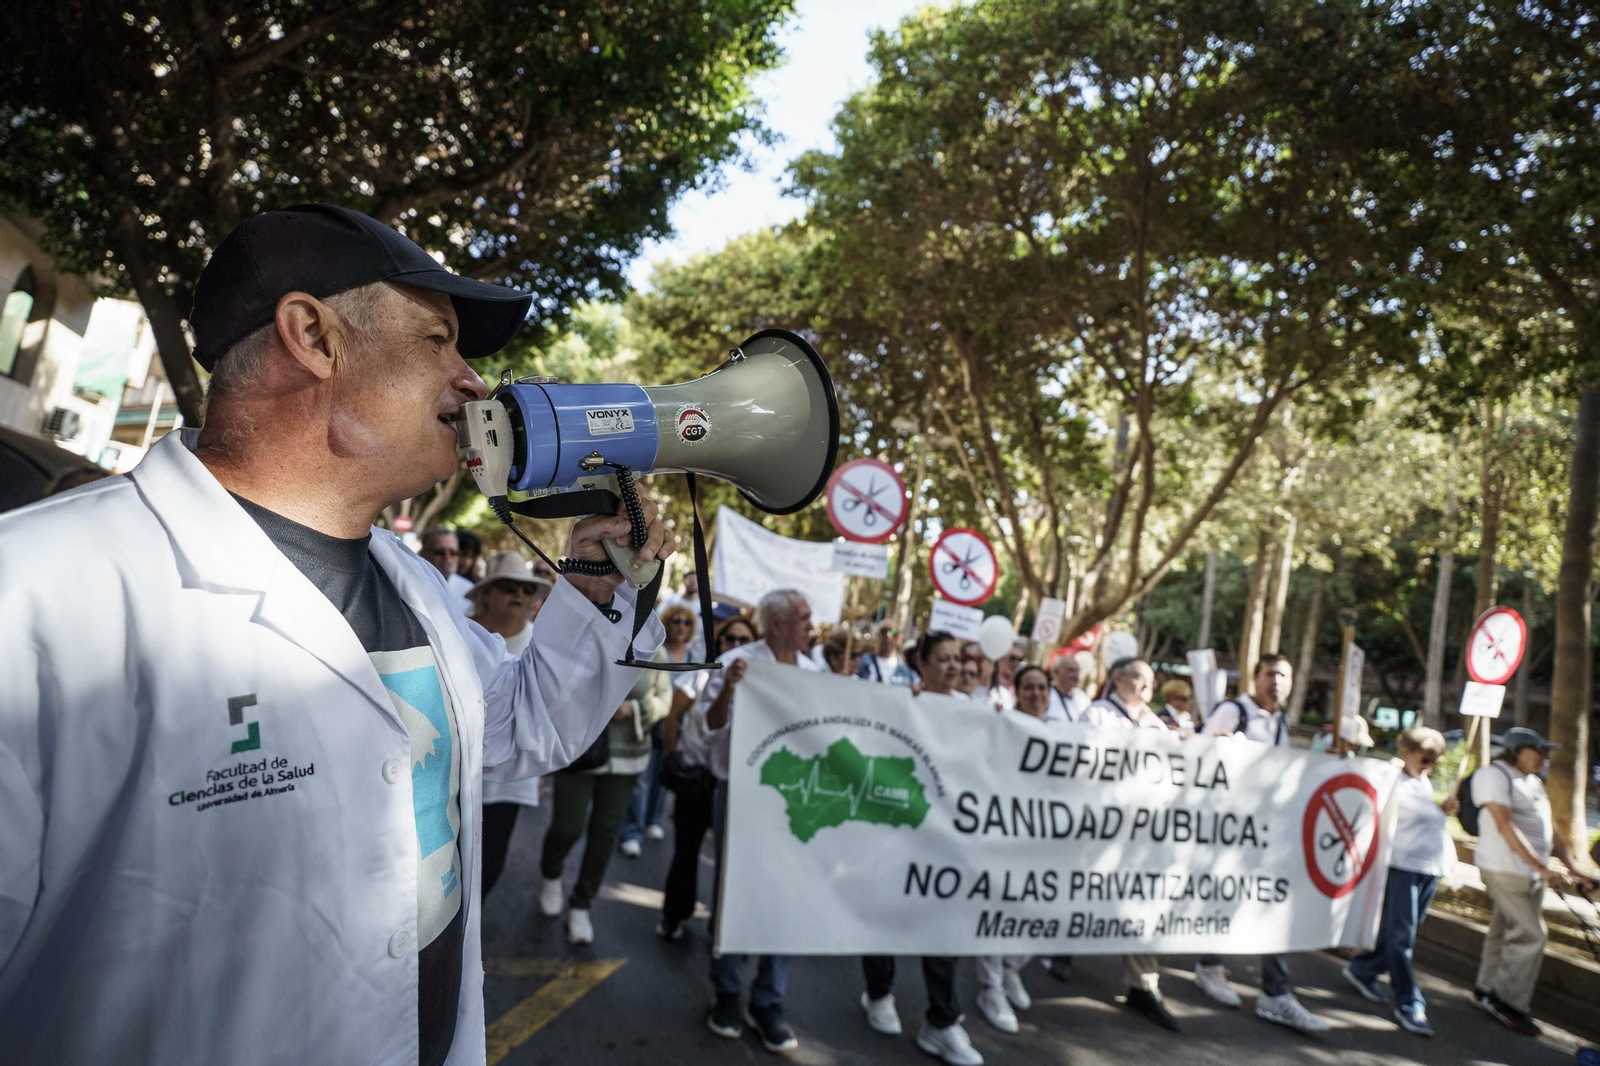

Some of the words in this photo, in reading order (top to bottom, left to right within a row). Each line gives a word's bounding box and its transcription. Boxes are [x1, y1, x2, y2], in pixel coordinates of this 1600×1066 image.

[588, 409, 629, 419] VONYX
[685, 427, 703, 436] CGT
[206, 757, 267, 783] Facultad
[271, 756, 288, 769] de
[746, 717, 820, 767] COORDINADORA
[822, 715, 872, 728] ANDALUZA
[874, 720, 888, 732] DE
[889, 727, 923, 757] MAREAS
[921, 753, 945, 798] BLANCAS
[1018, 736, 1185, 787] DEFIENDE
[1194, 755, 1229, 790] LA
[168, 781, 234, 806] Ciencias
[238, 776, 258, 789] de
[262, 773, 274, 785] la
[277, 763, 315, 782] Salud
[197, 791, 249, 812] Universidad
[251, 790, 262, 799] de
[263, 783, 295, 797] Almería
[953, 790, 1124, 841] SANIDAD
[904, 862, 962, 900] NO
[968, 870, 991, 900] A
[1002, 870, 1058, 901] LAS
[1069, 870, 1290, 903] PRIVATIZACIONES
[976, 910, 1059, 939] Marea
[1067, 912, 1145, 939] Blanca
